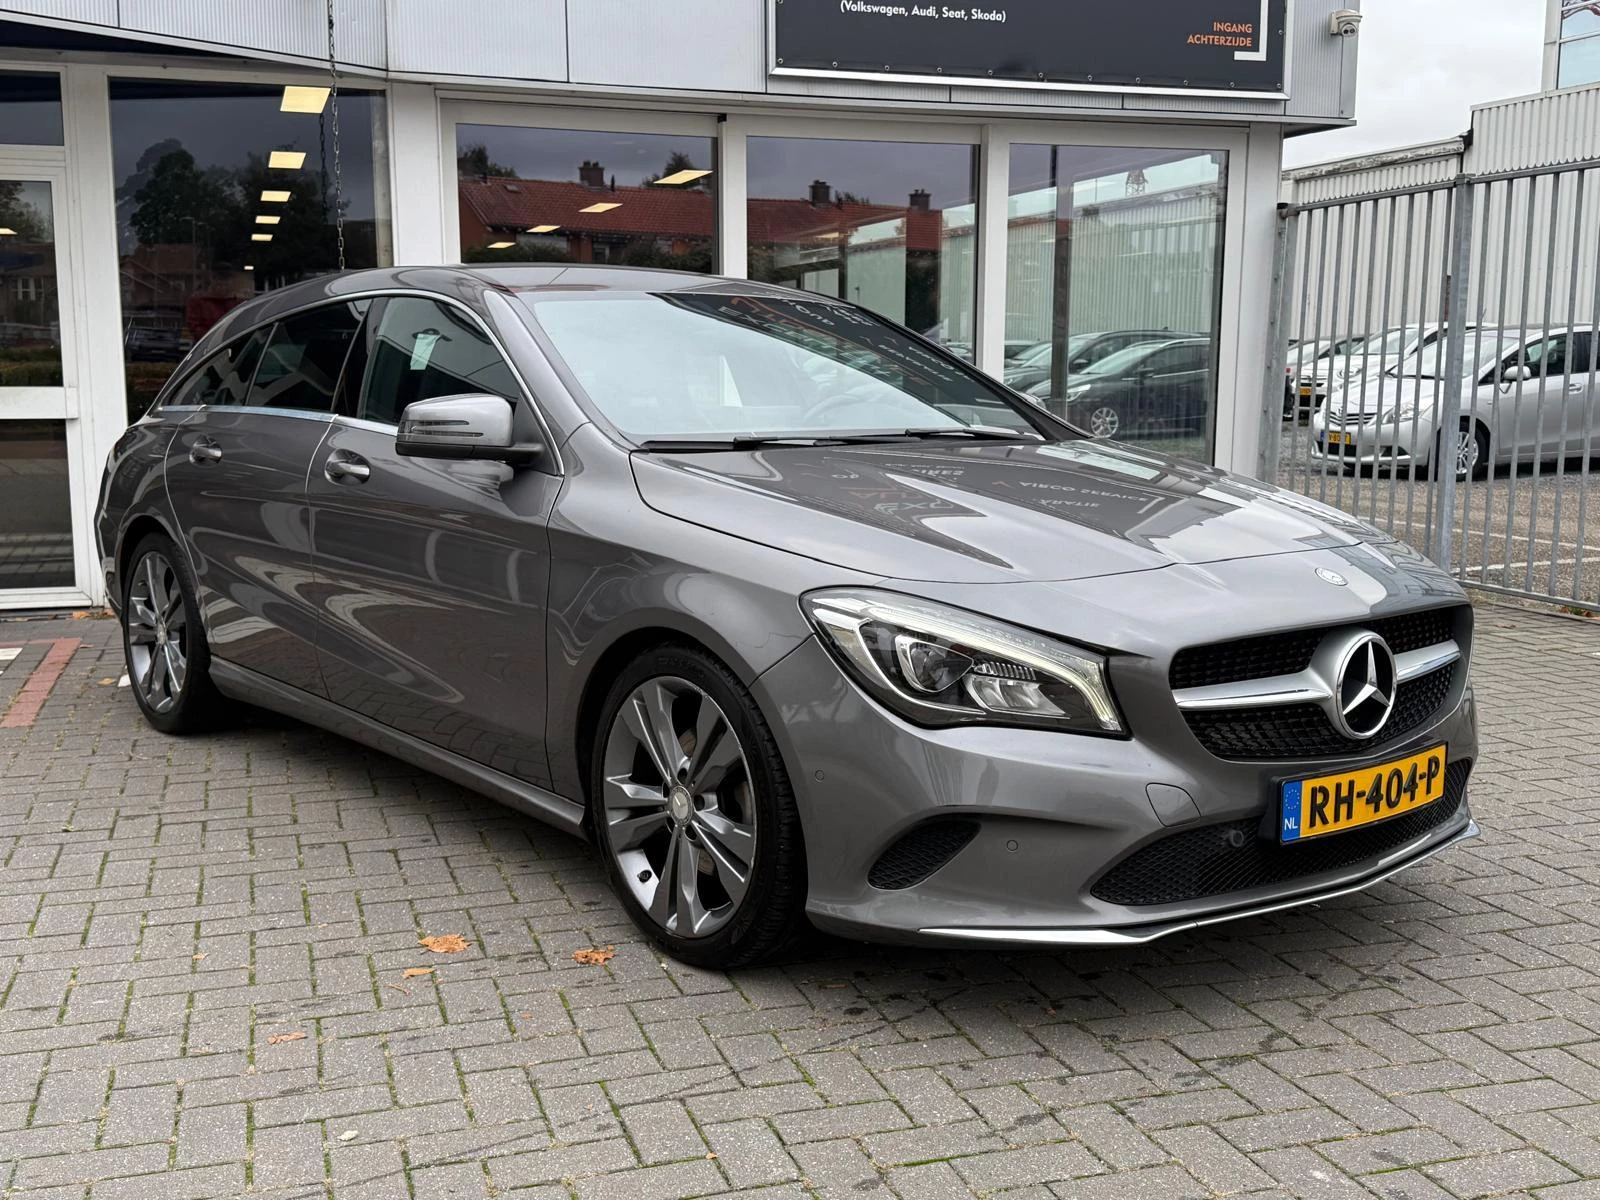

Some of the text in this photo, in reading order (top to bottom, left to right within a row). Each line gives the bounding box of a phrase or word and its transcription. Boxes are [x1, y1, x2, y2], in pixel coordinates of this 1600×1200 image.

[911, 5, 939, 20] Audi,
[942, 6, 968, 21] Seat,
[971, 8, 1007, 23] Skoda)
[1213, 22, 1253, 33] INGANG
[1187, 34, 1253, 47] ACHTERZIJDE
[1308, 755, 1441, 828] RH-404-P
[1283, 817, 1299, 831] NL
